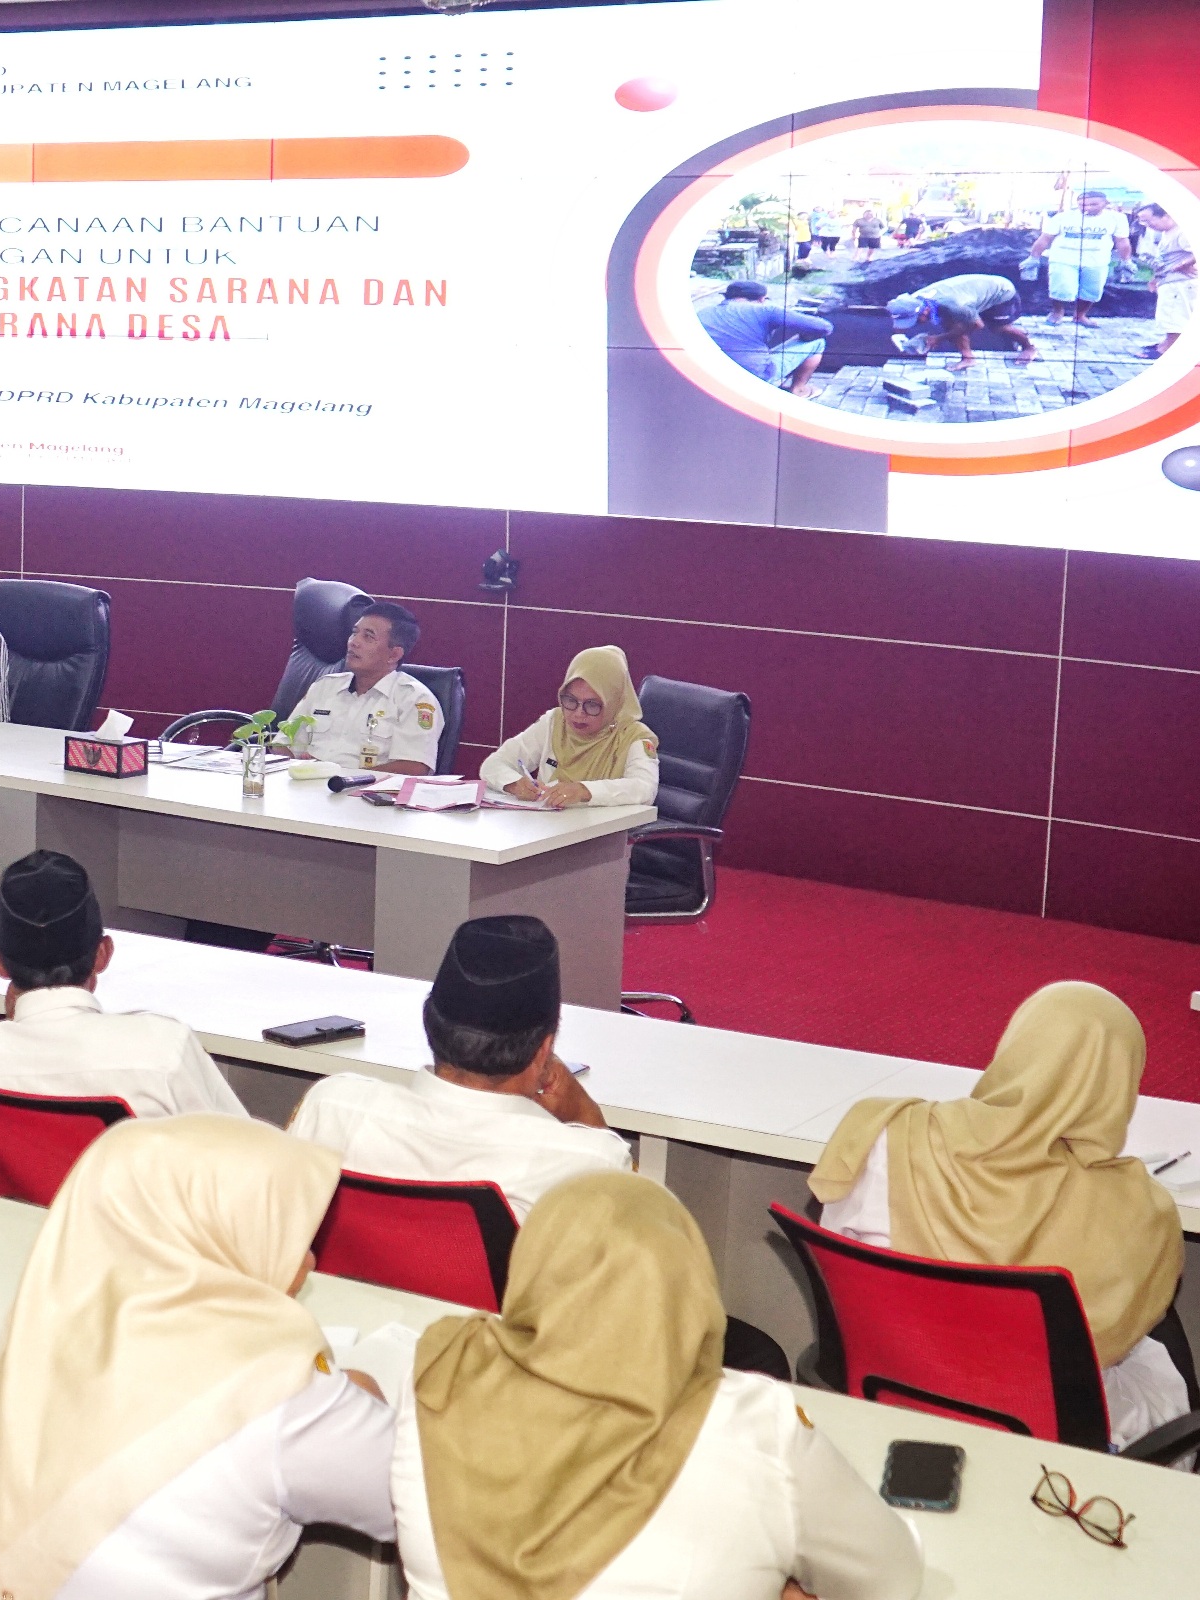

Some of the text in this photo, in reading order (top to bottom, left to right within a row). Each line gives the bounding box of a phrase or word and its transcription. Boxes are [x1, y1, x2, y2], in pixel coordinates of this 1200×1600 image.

[103, 76, 252, 92] MAGELANG
[182, 215, 379, 233] BANTUAN
[99, 248, 237, 265] UNTUK
[169, 276, 340, 306] SARANA
[363, 278, 448, 307] DAN
[127, 314, 232, 341] DESA
[82, 392, 228, 411] Kabupaten
[238, 397, 373, 417] Magelang
[28, 442, 124, 455] Magelang
